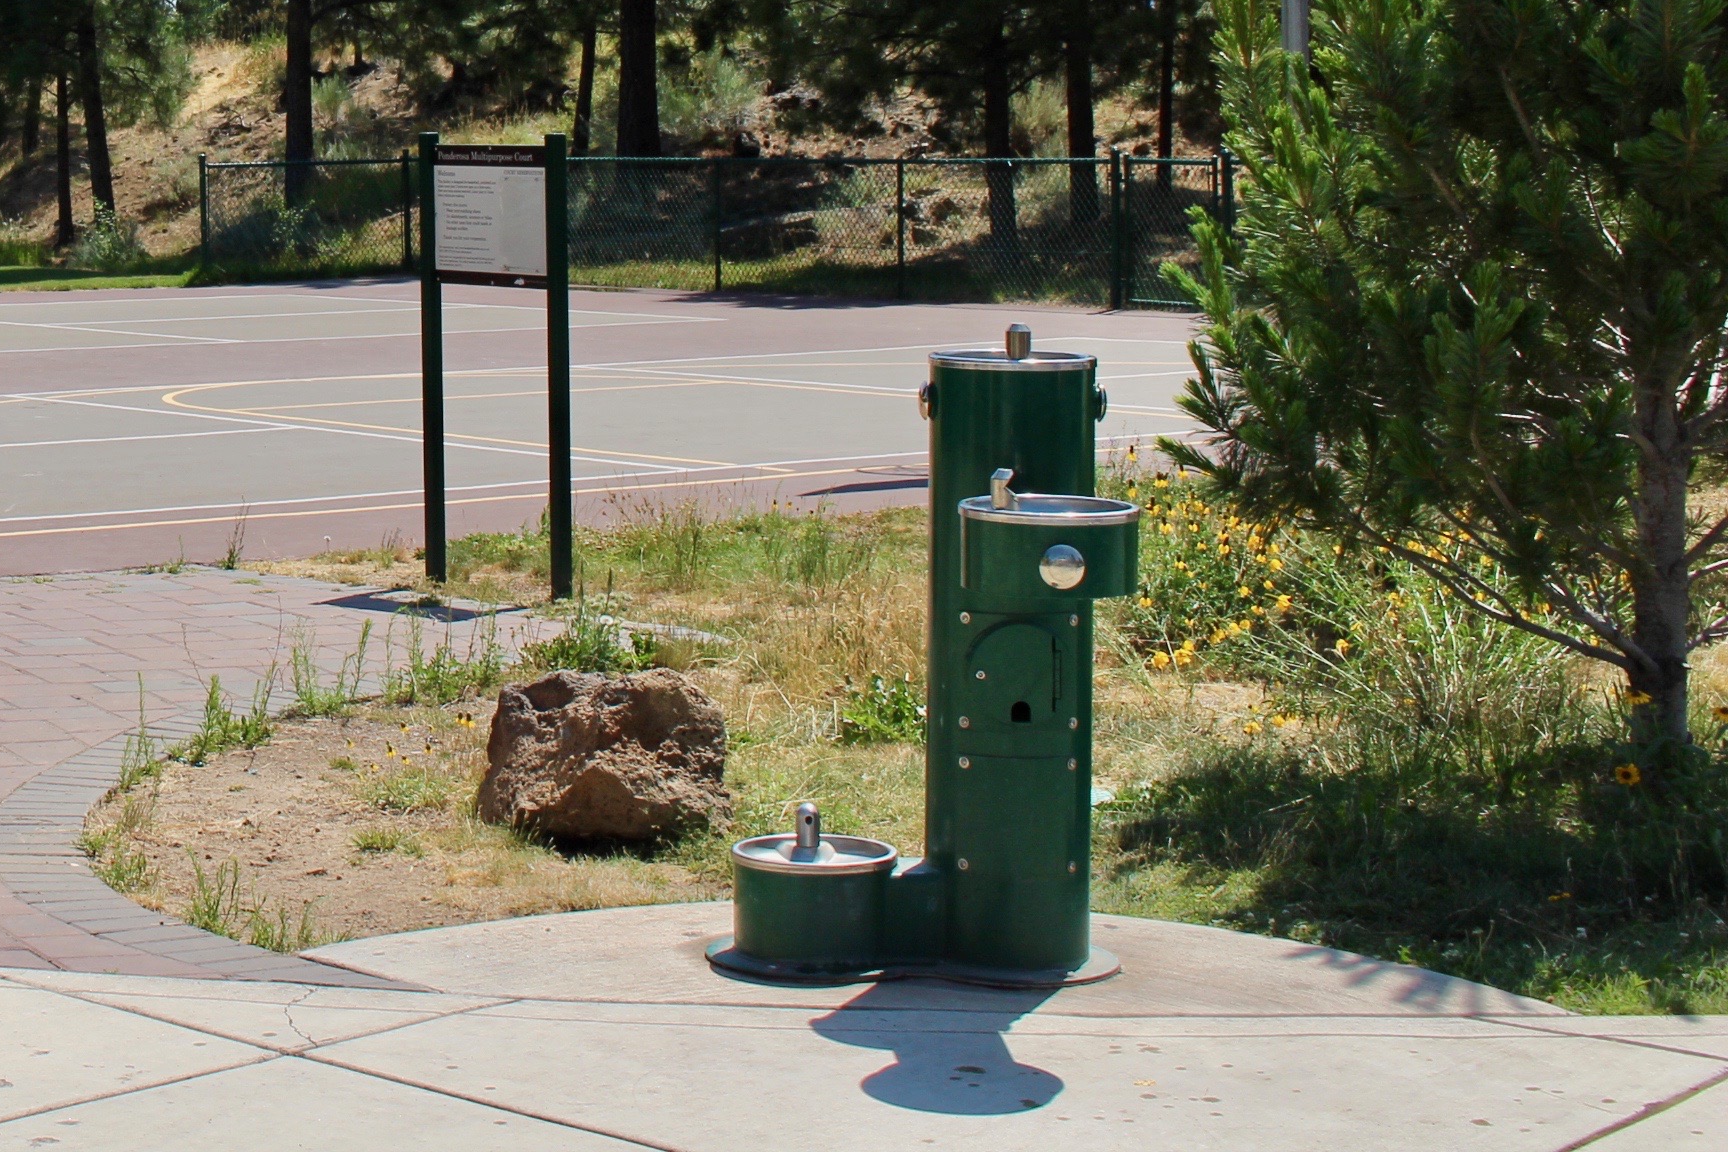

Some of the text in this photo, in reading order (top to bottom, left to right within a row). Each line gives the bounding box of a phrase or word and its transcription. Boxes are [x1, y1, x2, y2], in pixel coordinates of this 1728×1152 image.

[438, 151, 533, 163] Ponderosa Multipurpose Court
